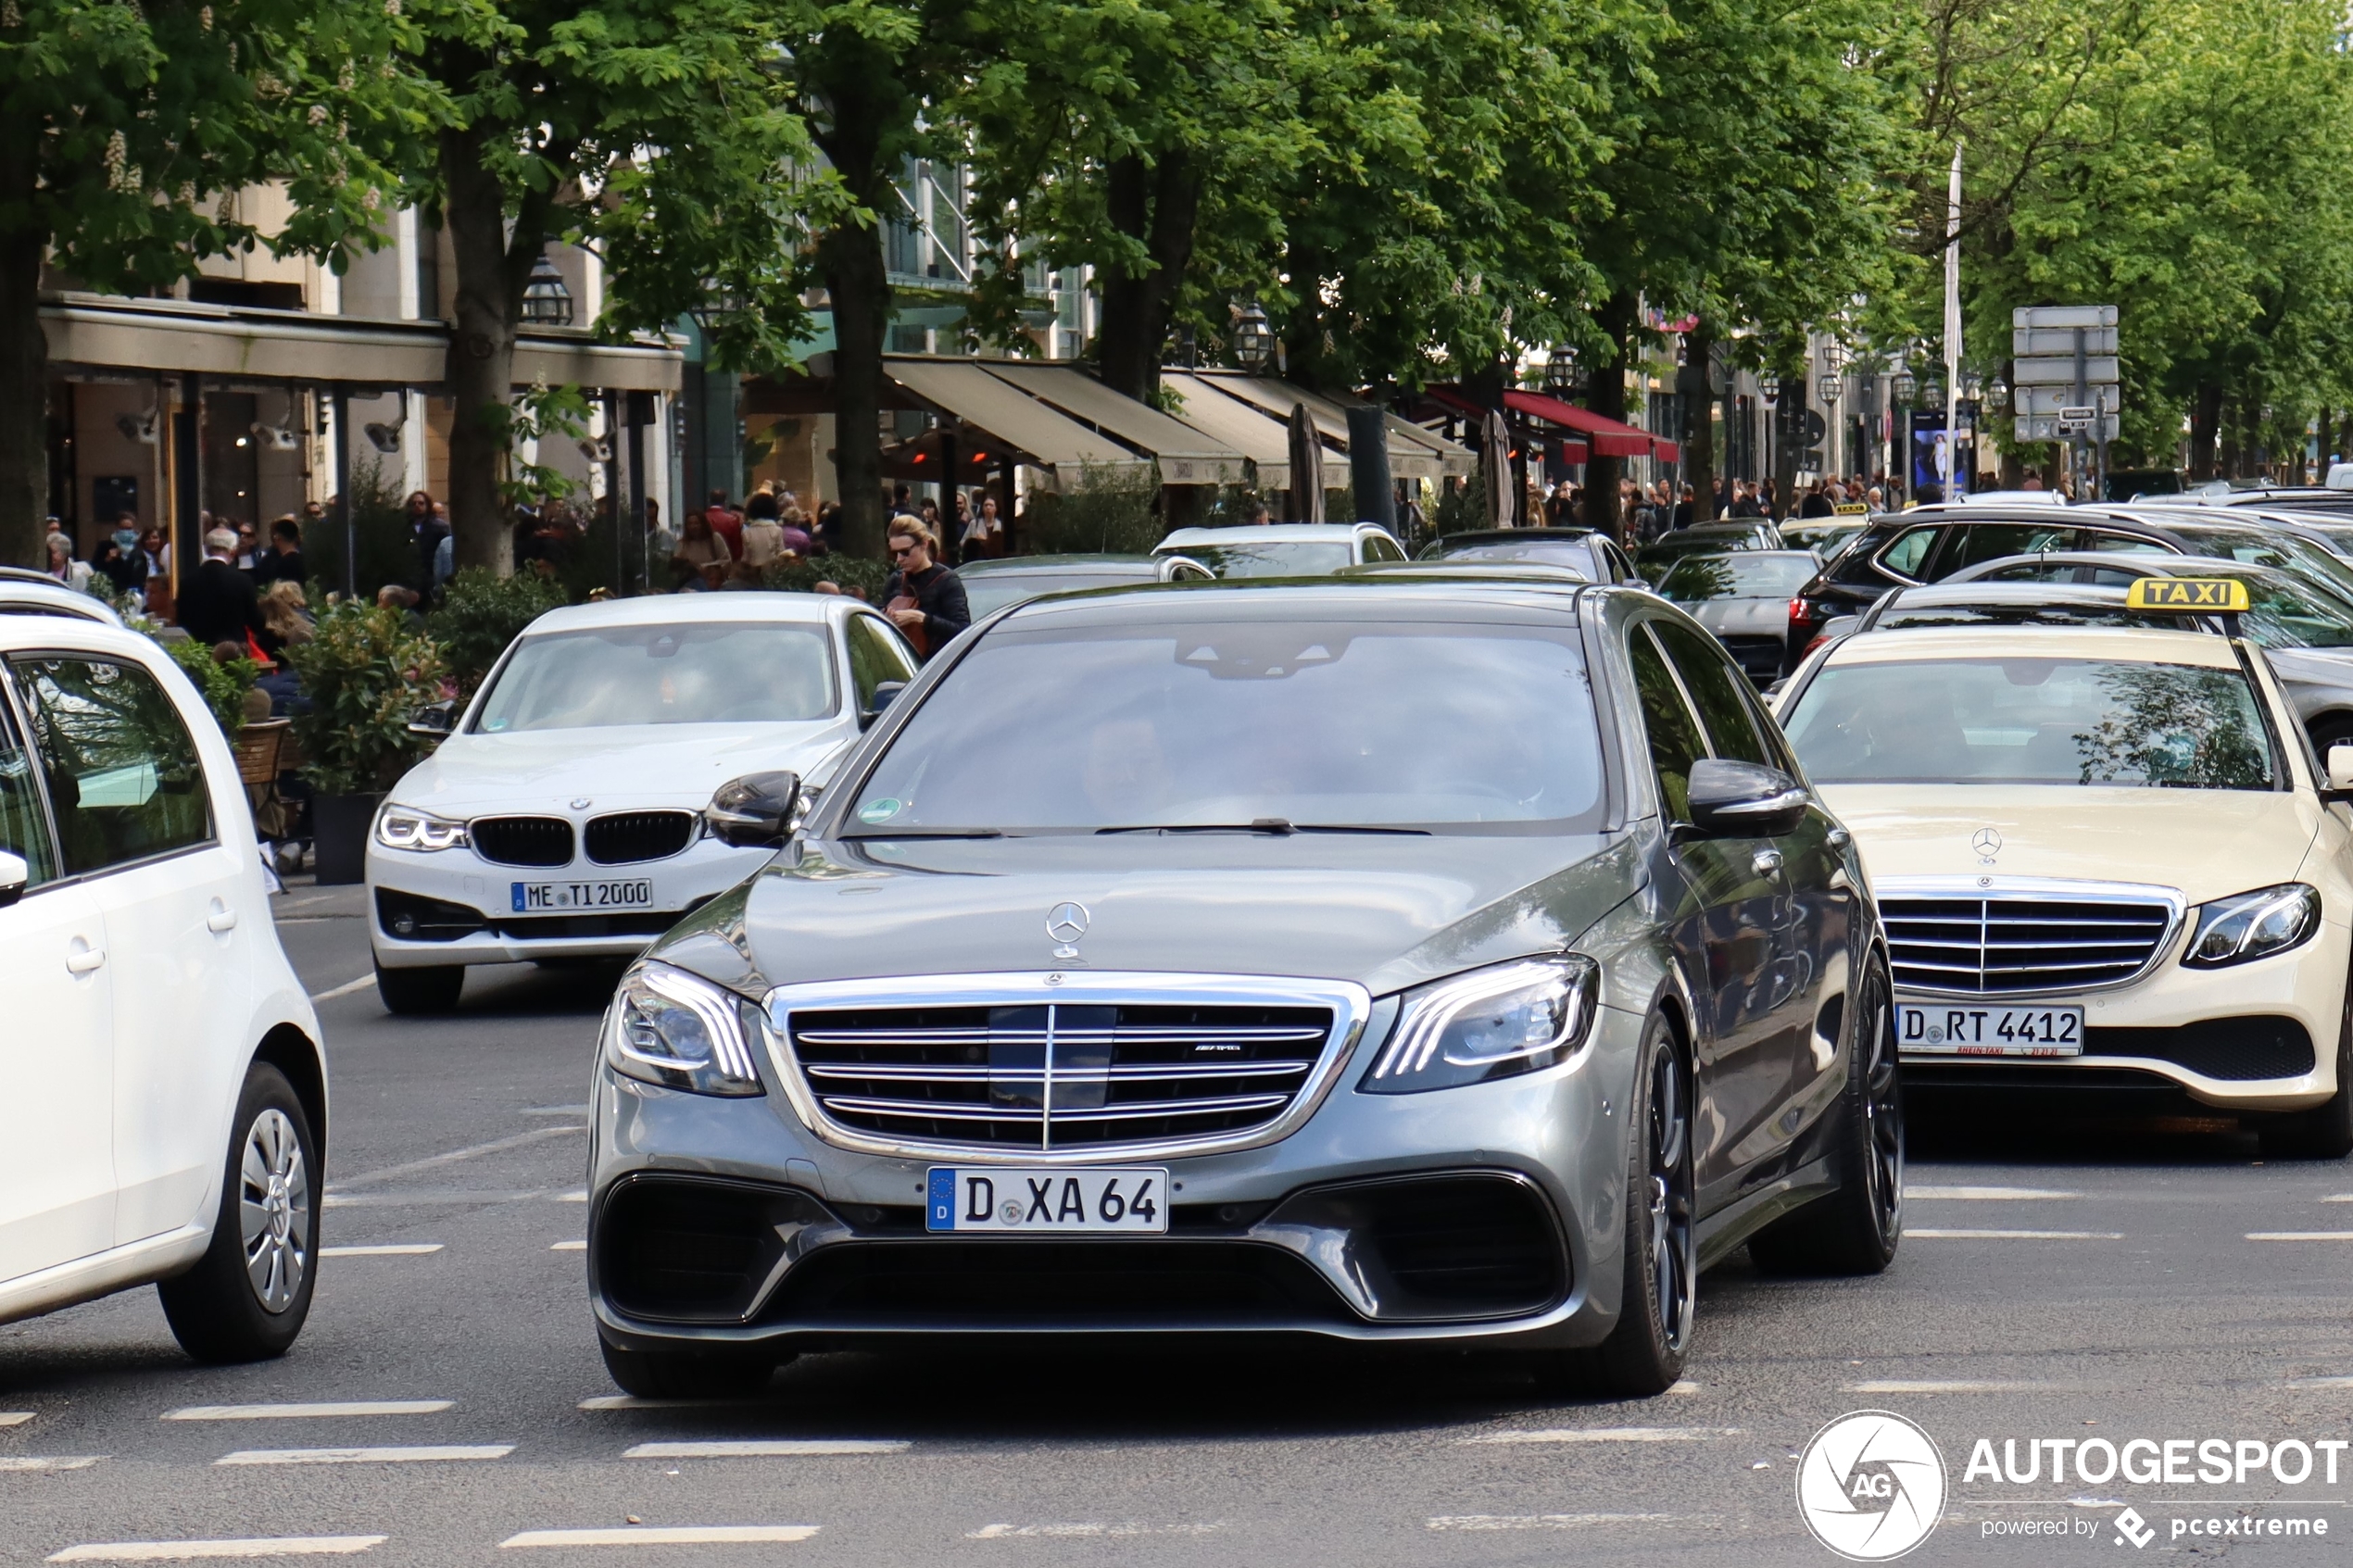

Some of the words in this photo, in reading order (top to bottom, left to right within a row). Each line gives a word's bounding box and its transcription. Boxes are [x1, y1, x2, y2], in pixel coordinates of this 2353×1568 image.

[2148, 583, 2226, 603] TAXI
[528, 885, 553, 907] ME
[569, 884, 593, 906] TI
[598, 883, 648, 905] 2000
[1905, 1010, 1924, 1039] D
[1946, 1010, 1988, 1041] RT
[1996, 1011, 2077, 1043] 4412
[965, 1177, 993, 1222] D
[1026, 1177, 1085, 1223] XA
[1099, 1178, 1155, 1223] 64
[937, 1207, 947, 1219] D
